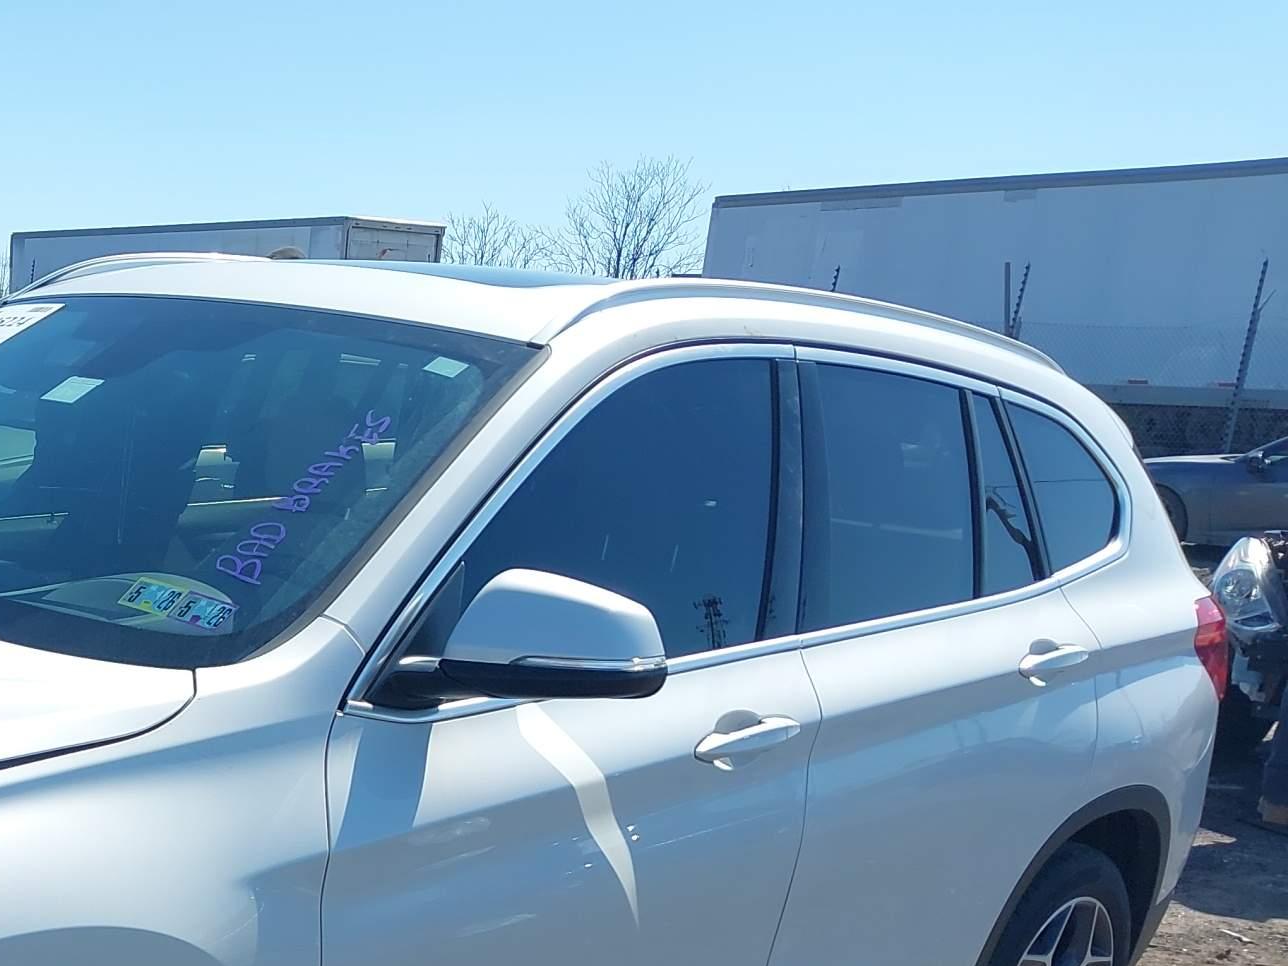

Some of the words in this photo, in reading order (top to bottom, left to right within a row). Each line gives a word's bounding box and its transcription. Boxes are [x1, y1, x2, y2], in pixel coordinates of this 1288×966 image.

[216, 522, 286, 585] BAD
[272, 409, 391, 512] BRAKES
[127, 585, 146, 603] 5
[177, 600, 196, 618] 5
